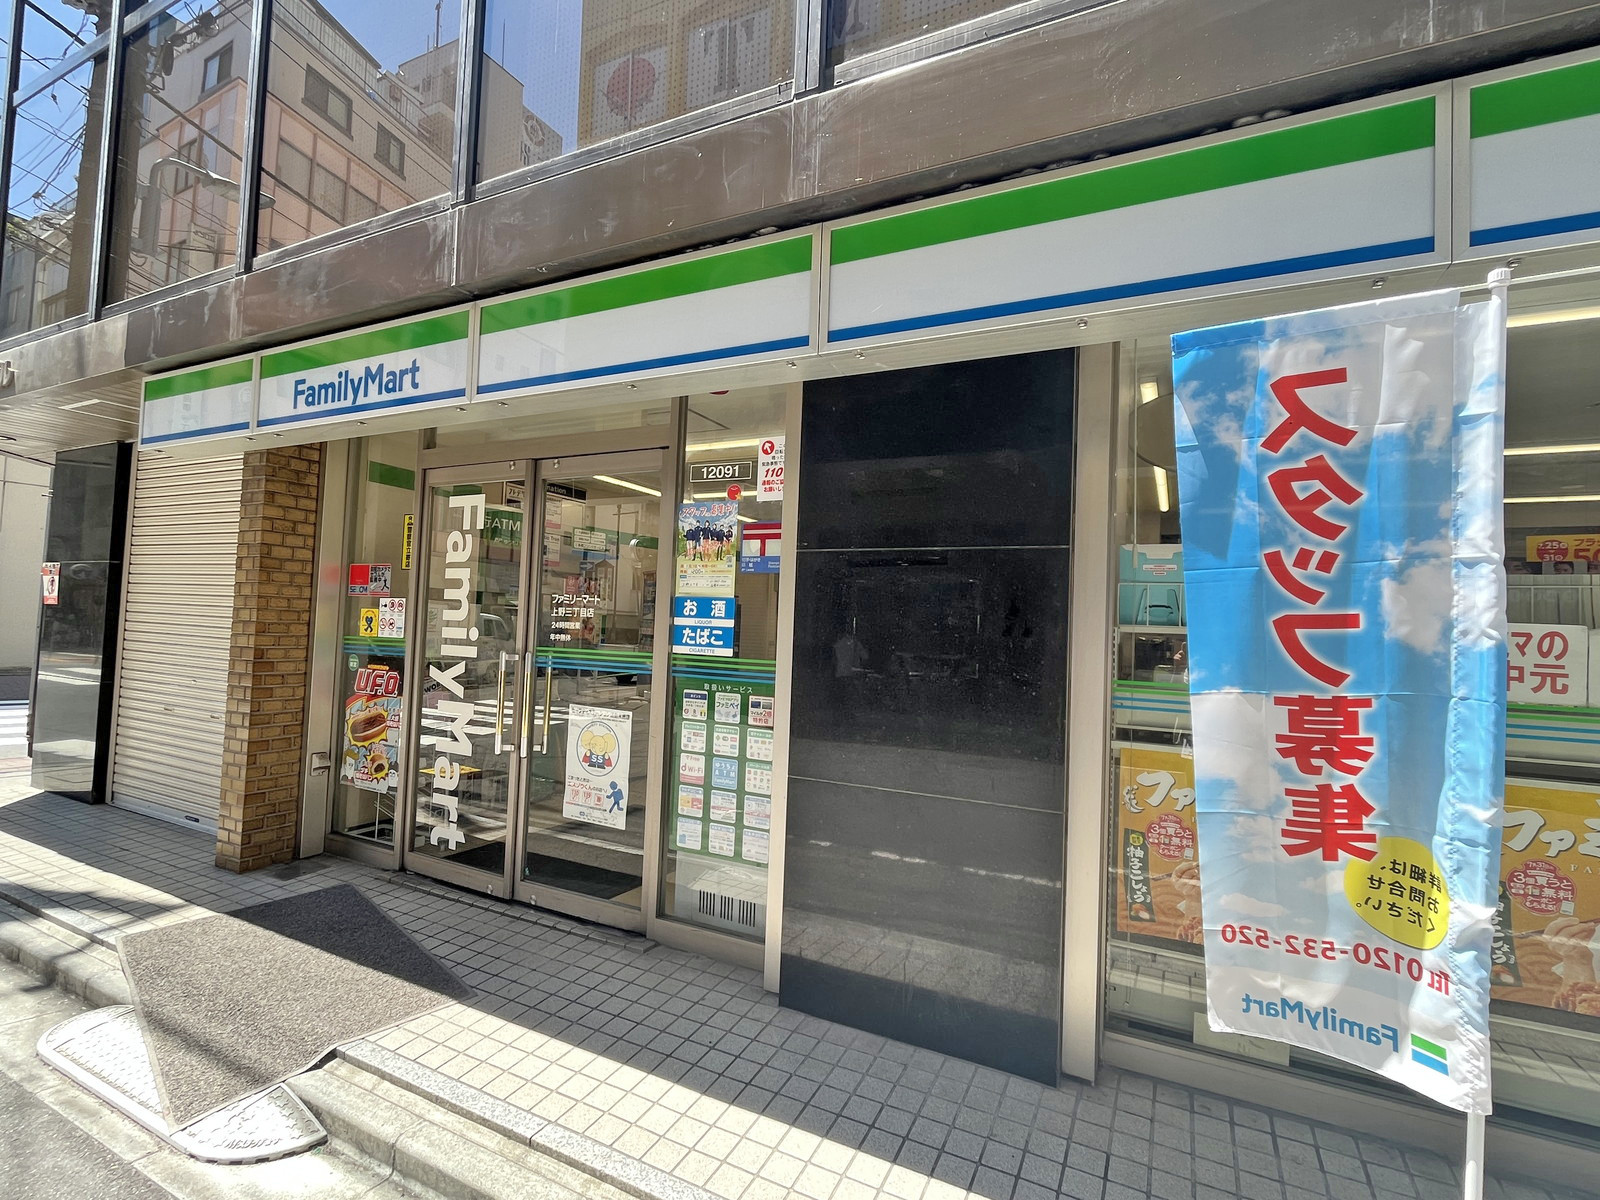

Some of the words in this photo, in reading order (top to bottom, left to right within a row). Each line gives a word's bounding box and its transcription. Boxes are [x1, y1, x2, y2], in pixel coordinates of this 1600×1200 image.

[293, 358, 420, 409] FamilyMart
[701, 465, 739, 479] 12091
[765, 467, 784, 478] 110
[552, 594, 601, 605] ファミリーマート
[551, 607, 595, 617] 上野三丁目店
[683, 600, 726, 617] お酒
[682, 627, 723, 645] たばこ
[1507, 631, 1569, 661] マの
[429, 493, 486, 850] FamilyMart
[704, 683, 753, 693] 取扱いサービス
[591, 754, 603, 763] SS
[1570, 863, 1600, 874] FA
[1513, 872, 1572, 889] 3個買うと
